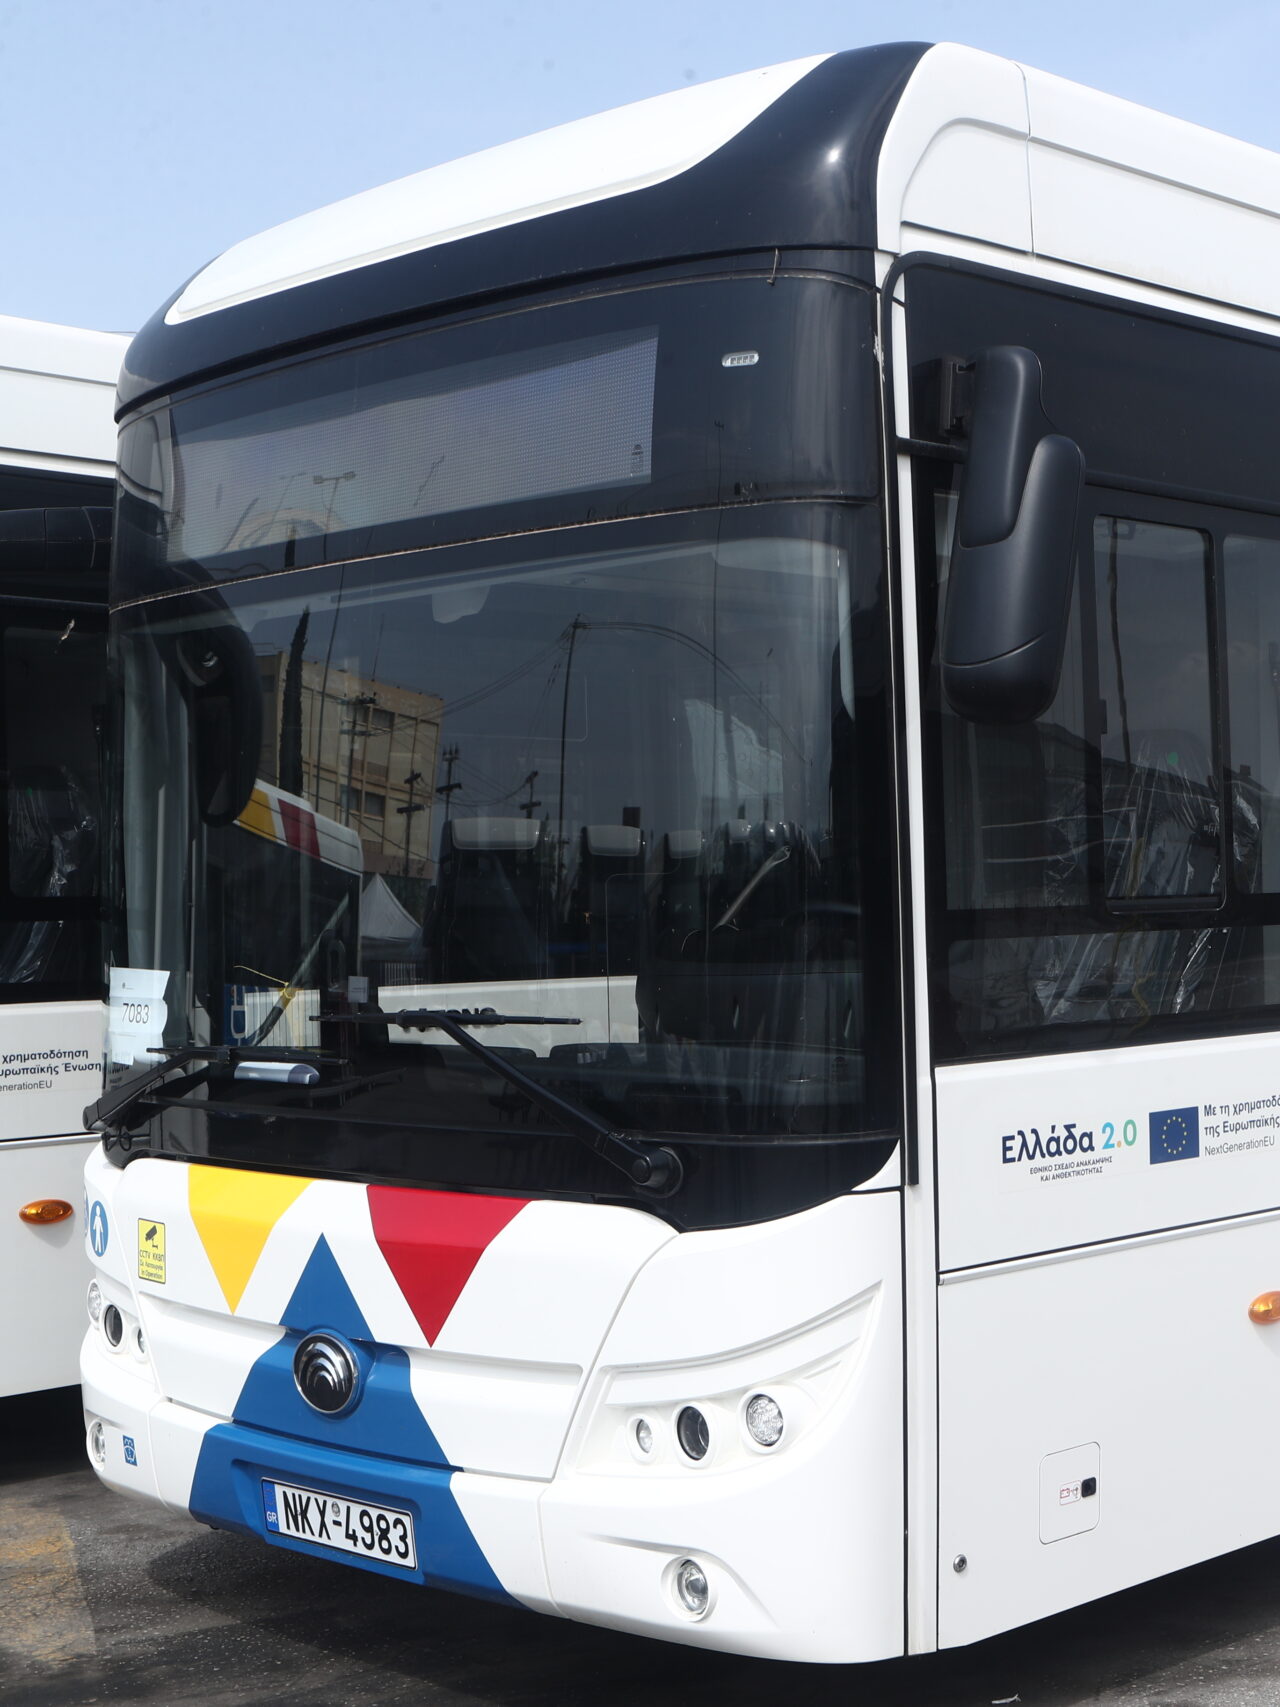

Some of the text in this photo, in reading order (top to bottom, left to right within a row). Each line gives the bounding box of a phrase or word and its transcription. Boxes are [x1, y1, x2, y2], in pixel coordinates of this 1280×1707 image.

[122, 1002, 150, 1024] 7083
[2, 1049, 89, 1065] χρηματοδότηση
[0, 1062, 102, 1078] υρωπαϊκής Ένωση
[0, 1080, 53, 1092] enerationEU
[1203, 1104, 1217, 1117] Με
[1219, 1104, 1230, 1117] τη
[1204, 1124, 1220, 1138] της
[1222, 1113, 1280, 1135] Ευρωπαϊκής
[1001, 1118, 1138, 1164] Ελλάδα 2.0
[1204, 1135, 1276, 1157] NextGenerationEU
[1029, 1156, 1113, 1175] ΕΘΝΙΚΟ ΣΧΕΔΙΟ ΑΝΑΚΑΜΨΗΣ
[1040, 1166, 1104, 1182] ΚΑΙ ΑΝΘΕΚΤΙΚΟΤΗΤΑΣ
[266, 1510, 278, 1524] GR
[282, 1490, 410, 1560] NKX-4983
